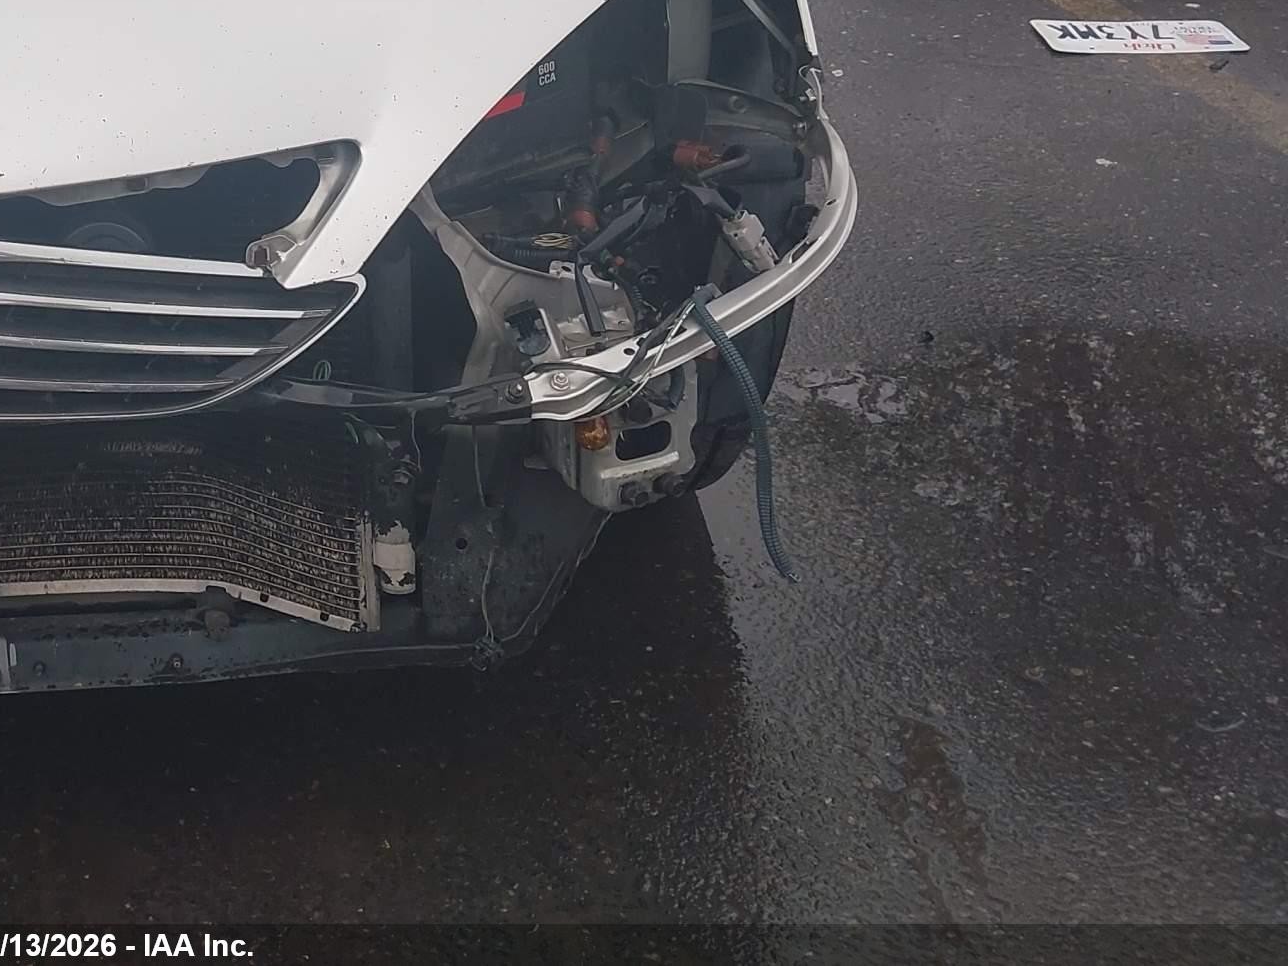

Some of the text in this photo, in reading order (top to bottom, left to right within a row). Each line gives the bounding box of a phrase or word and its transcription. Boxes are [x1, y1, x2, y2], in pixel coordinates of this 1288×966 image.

[1047, 23, 1175, 40] 7Y3MK
[538, 60, 555, 75] 600
[538, 72, 557, 86] CCA
